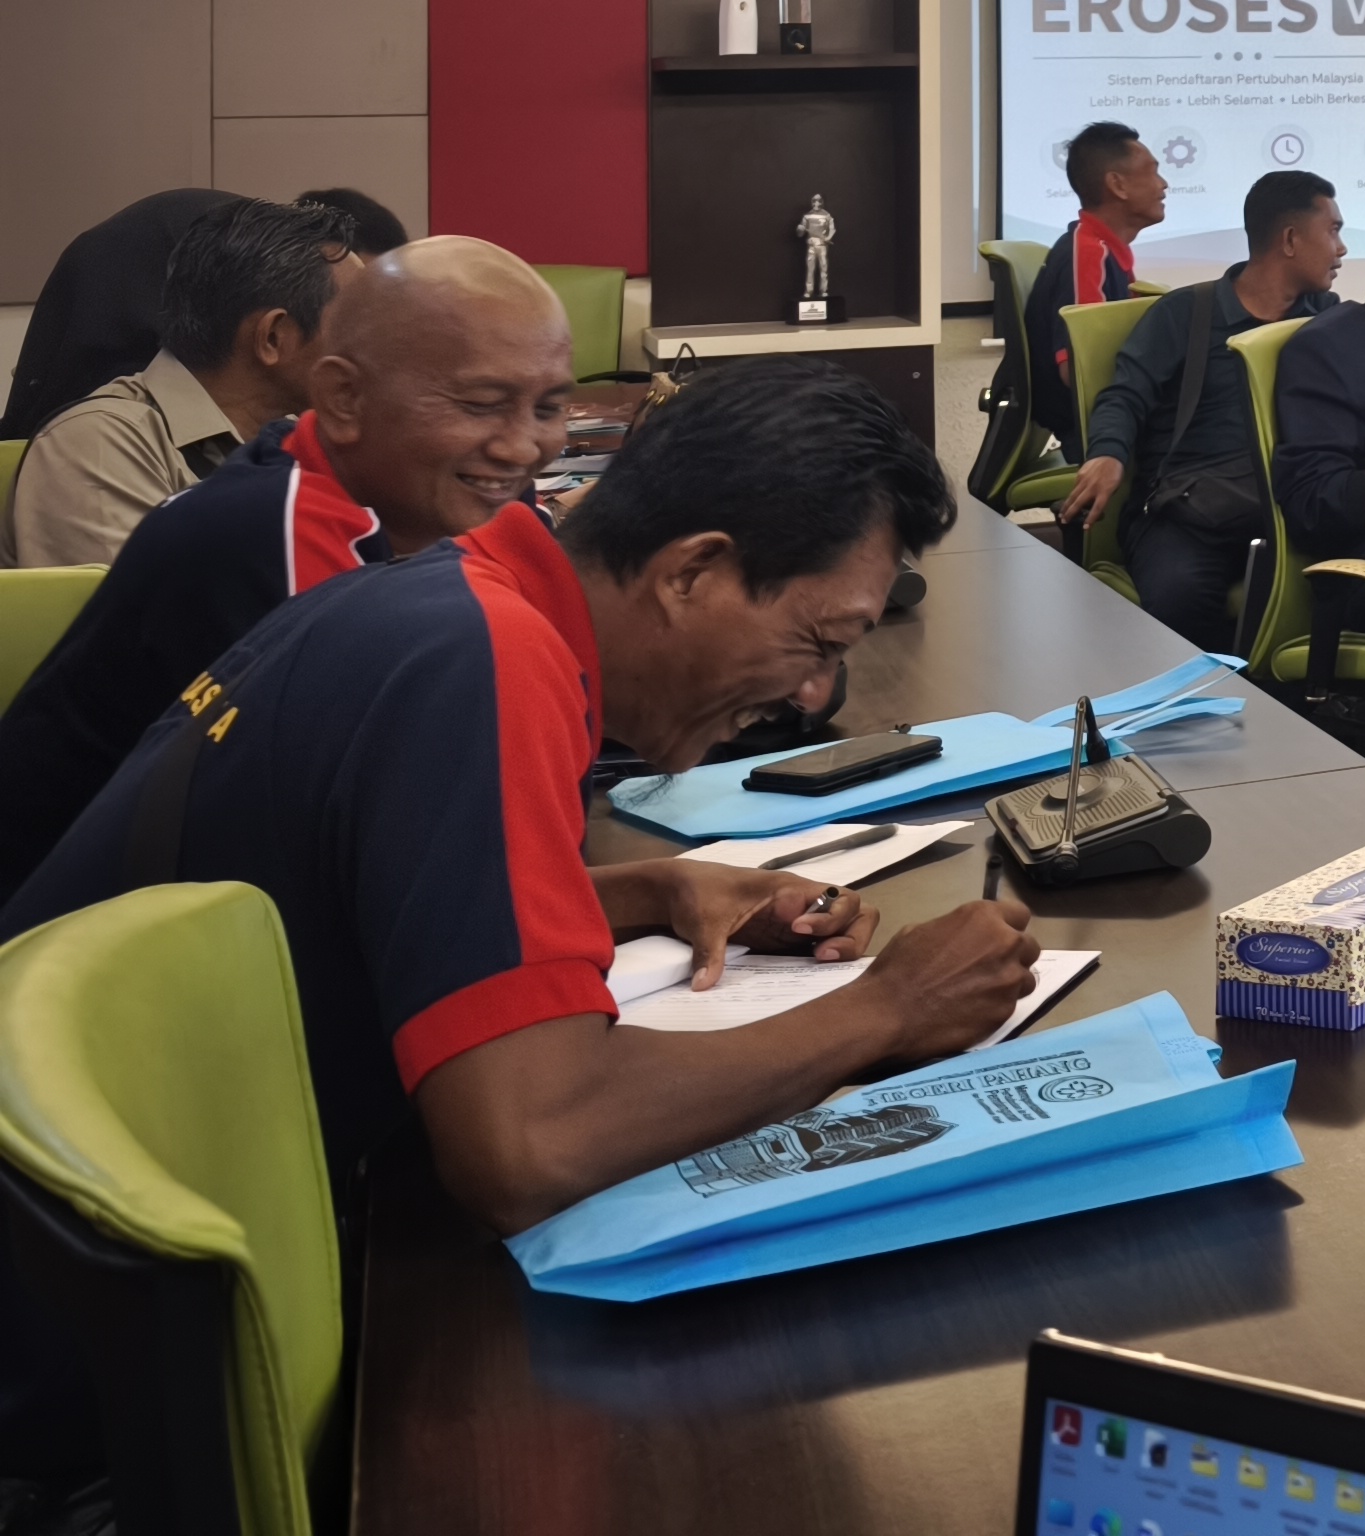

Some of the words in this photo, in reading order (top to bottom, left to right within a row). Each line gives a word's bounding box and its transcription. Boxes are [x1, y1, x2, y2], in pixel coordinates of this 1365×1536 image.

[1107, 73, 1153, 86] Sistem
[1155, 73, 1233, 86] Pendaftaran
[1236, 72, 1310, 85] Pertubuhan
[1312, 71, 1364, 87] Malaysia
[1089, 95, 1124, 108] Lebih
[1127, 95, 1171, 108] Pantas
[1187, 94, 1221, 107] Lebih
[1224, 93, 1274, 106] Selamat
[1291, 93, 1324, 106] Lebih
[1168, 185, 1206, 195] tematik
[1246, 936, 1315, 964] Superior
[1255, 1006, 1268, 1016] 70
[976, 1057, 1092, 1088] PAHANG
